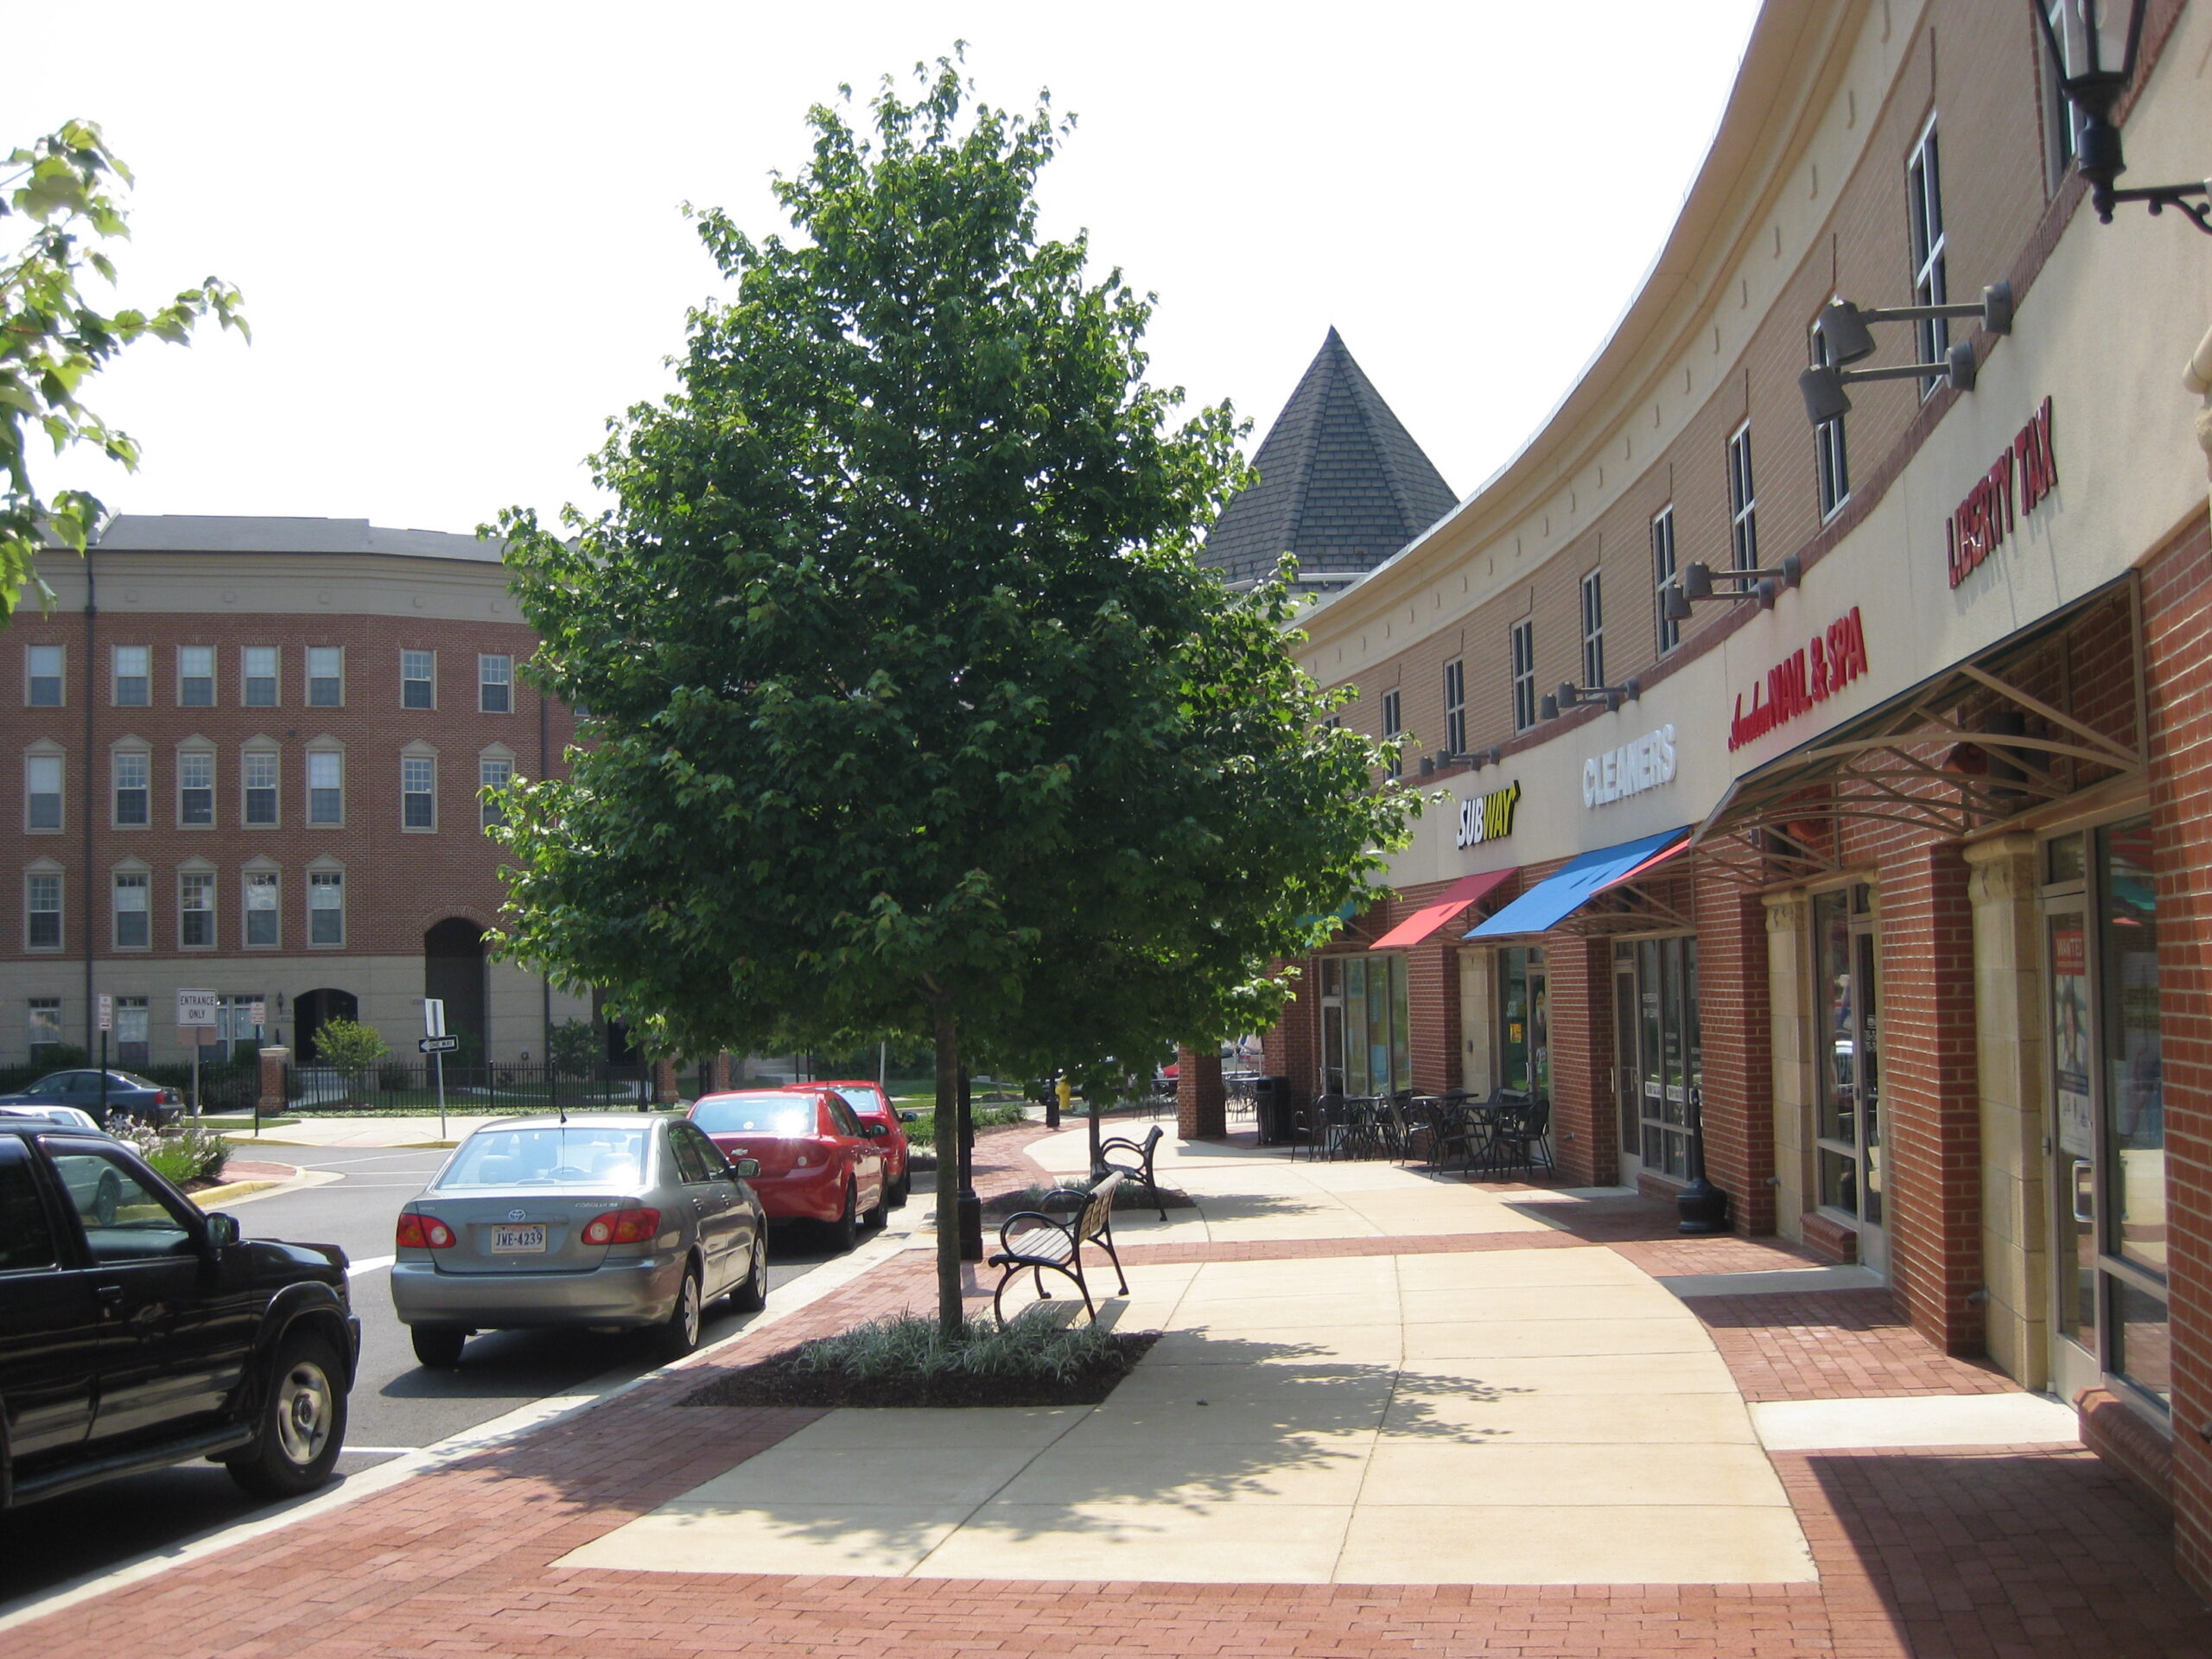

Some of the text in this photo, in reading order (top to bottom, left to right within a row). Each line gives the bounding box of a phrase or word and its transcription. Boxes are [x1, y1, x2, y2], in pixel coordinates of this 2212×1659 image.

[1946, 395, 2057, 589] LIBERTY TAX
[1768, 648, 1812, 728] NAIL
[1810, 636, 1829, 702] &
[1826, 606, 1867, 693] SPA
[1583, 724, 1677, 809] CLEANERS
[1457, 779, 1521, 849] SUBWAY
[180, 995, 214, 1006] ENTRANCE
[188, 1009, 206, 1020] ONLY
